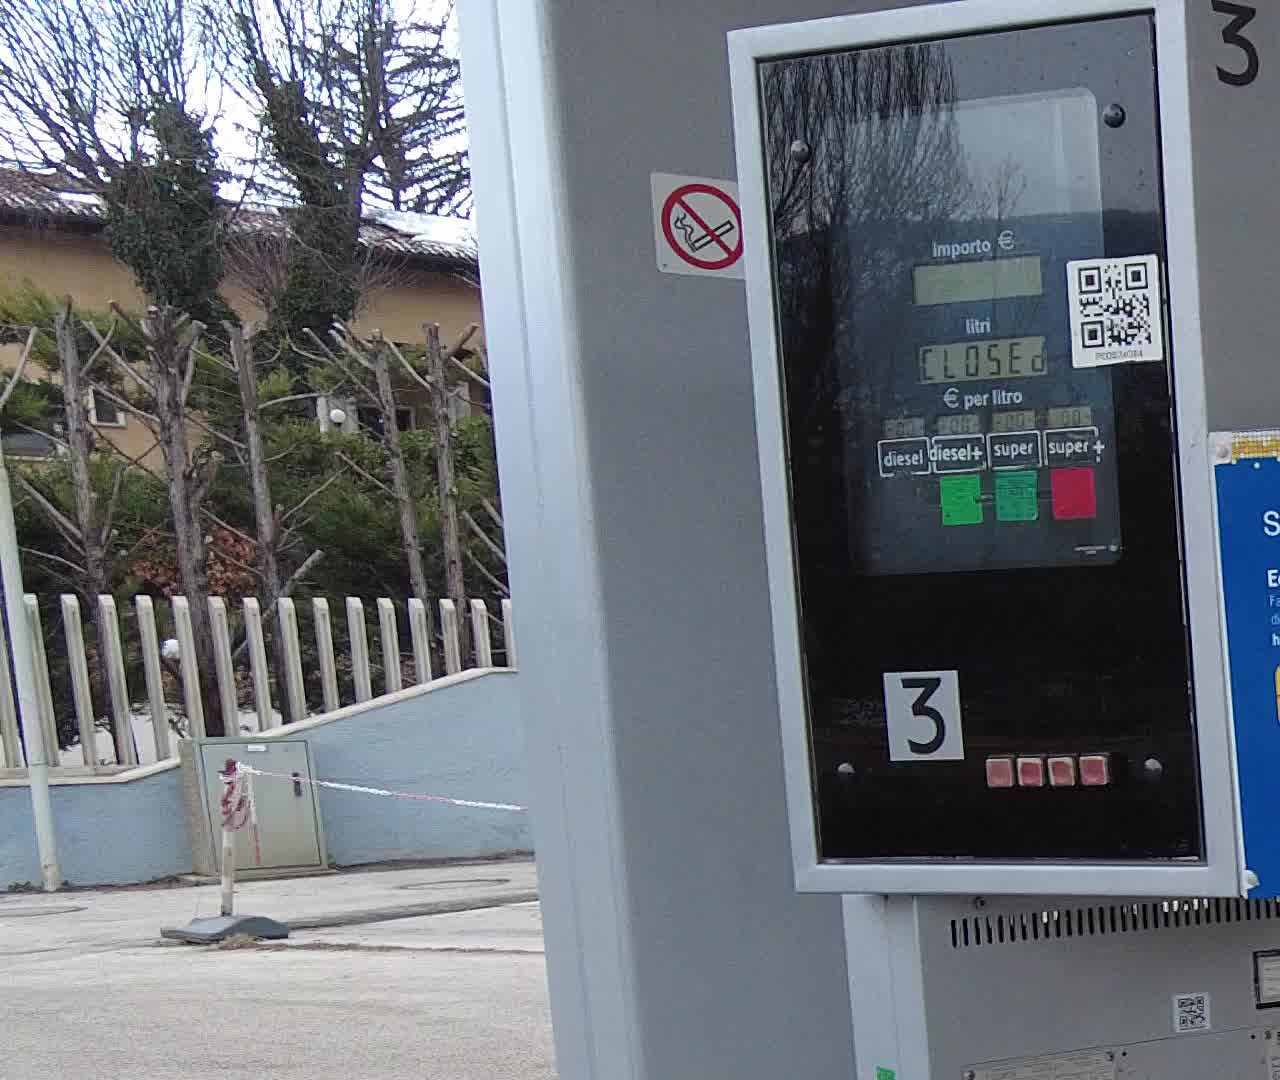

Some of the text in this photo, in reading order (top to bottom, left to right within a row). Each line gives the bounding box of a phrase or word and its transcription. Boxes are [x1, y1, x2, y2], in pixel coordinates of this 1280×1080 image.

[1210, 0, 1260, 87] 3
[932, 230, 1016, 259] importo €
[966, 316, 992, 335] litri
[943, 388, 1023, 410] € per litro
[993, 441, 1034, 459] super
[1048, 438, 1090, 456] super
[883, 451, 924, 468] diesel
[901, 677, 946, 754] 3
